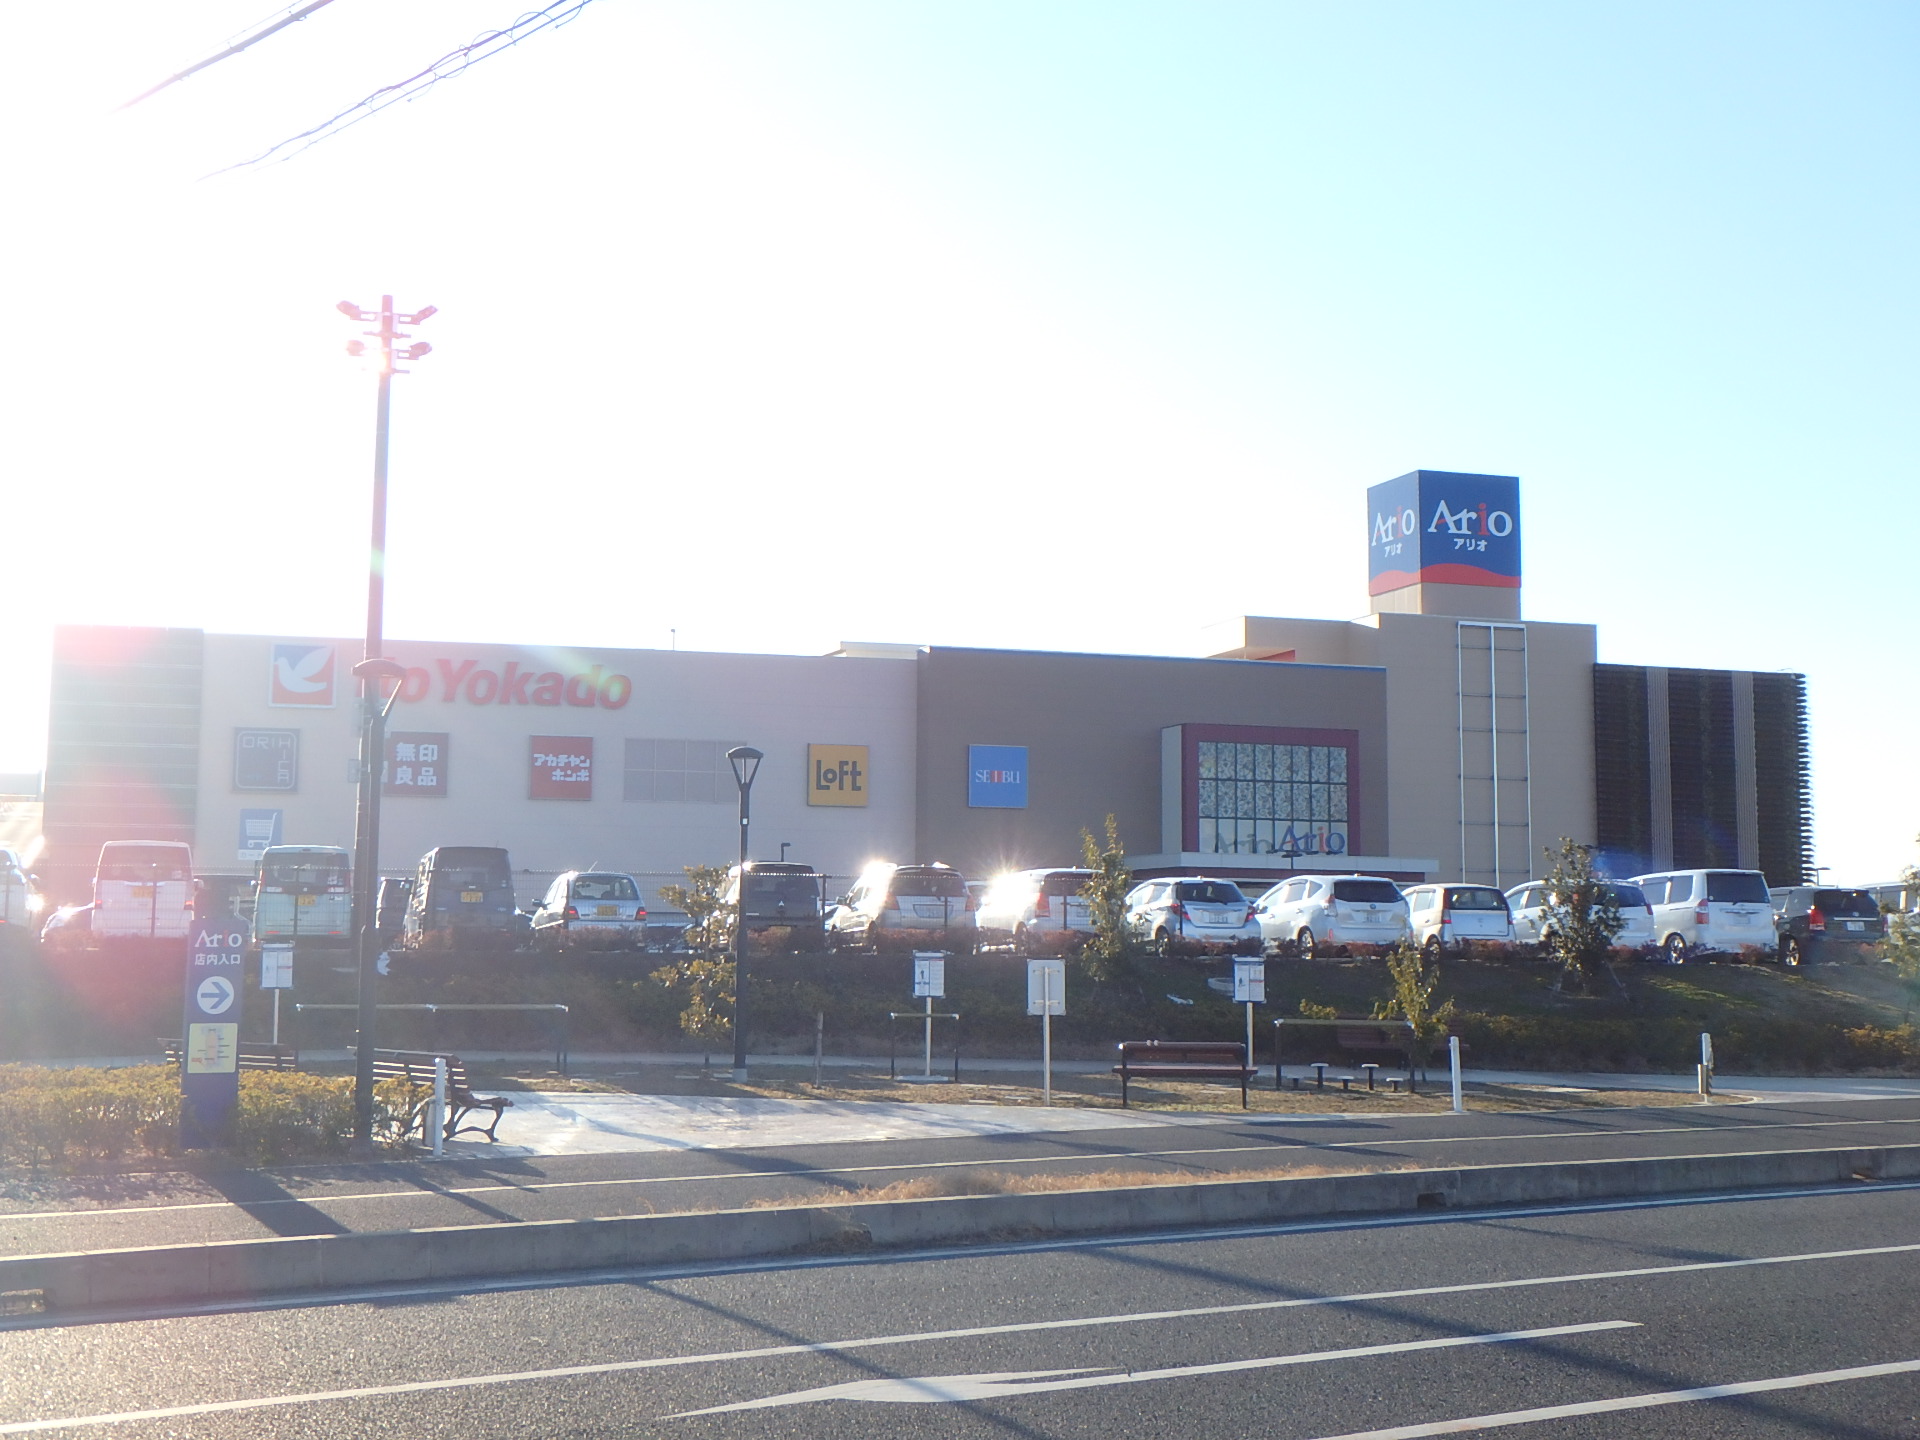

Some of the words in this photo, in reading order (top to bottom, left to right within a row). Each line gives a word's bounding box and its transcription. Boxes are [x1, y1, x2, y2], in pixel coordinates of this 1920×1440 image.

[1371, 505, 1416, 546] Ario
[1427, 499, 1513, 537] Ario
[1384, 543, 1403, 558] アリオ
[1453, 538, 1488, 552] アリオ
[355, 656, 632, 710] toYokado
[395, 742, 438, 763] 無印
[395, 765, 437, 786] 良品
[975, 769, 1020, 784] SEIBU
[1275, 825, 1346, 854] Ario
[194, 929, 243, 948] Ario
[194, 954, 241, 966] 店内入口
